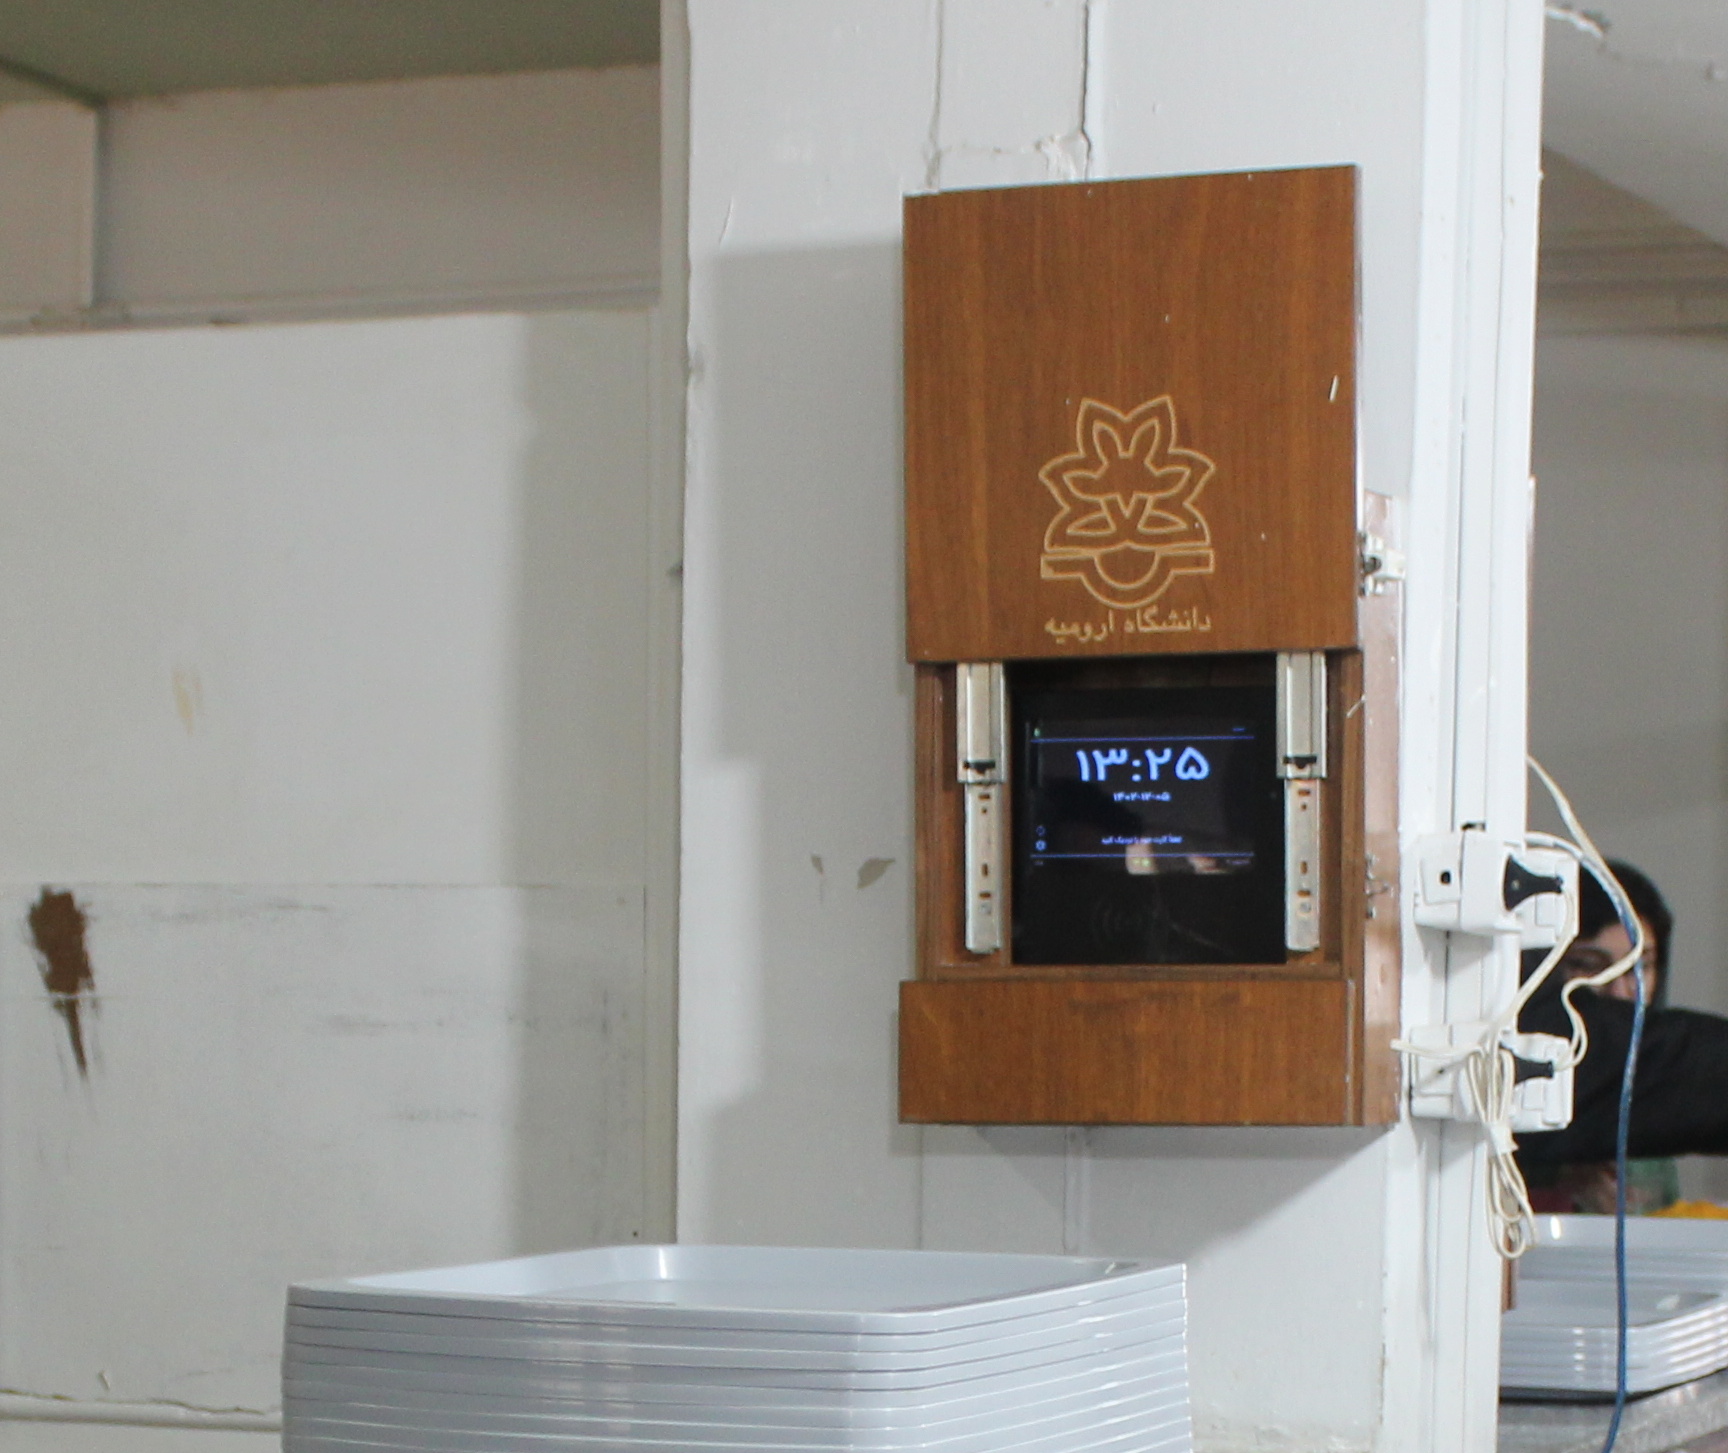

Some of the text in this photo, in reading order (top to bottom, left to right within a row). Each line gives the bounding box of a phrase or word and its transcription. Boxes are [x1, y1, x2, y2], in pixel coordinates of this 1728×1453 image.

[1044, 604, 1212, 645] دانشگاه ارومیه
[1076, 746, 1210, 782] ۱۳:۲۵
